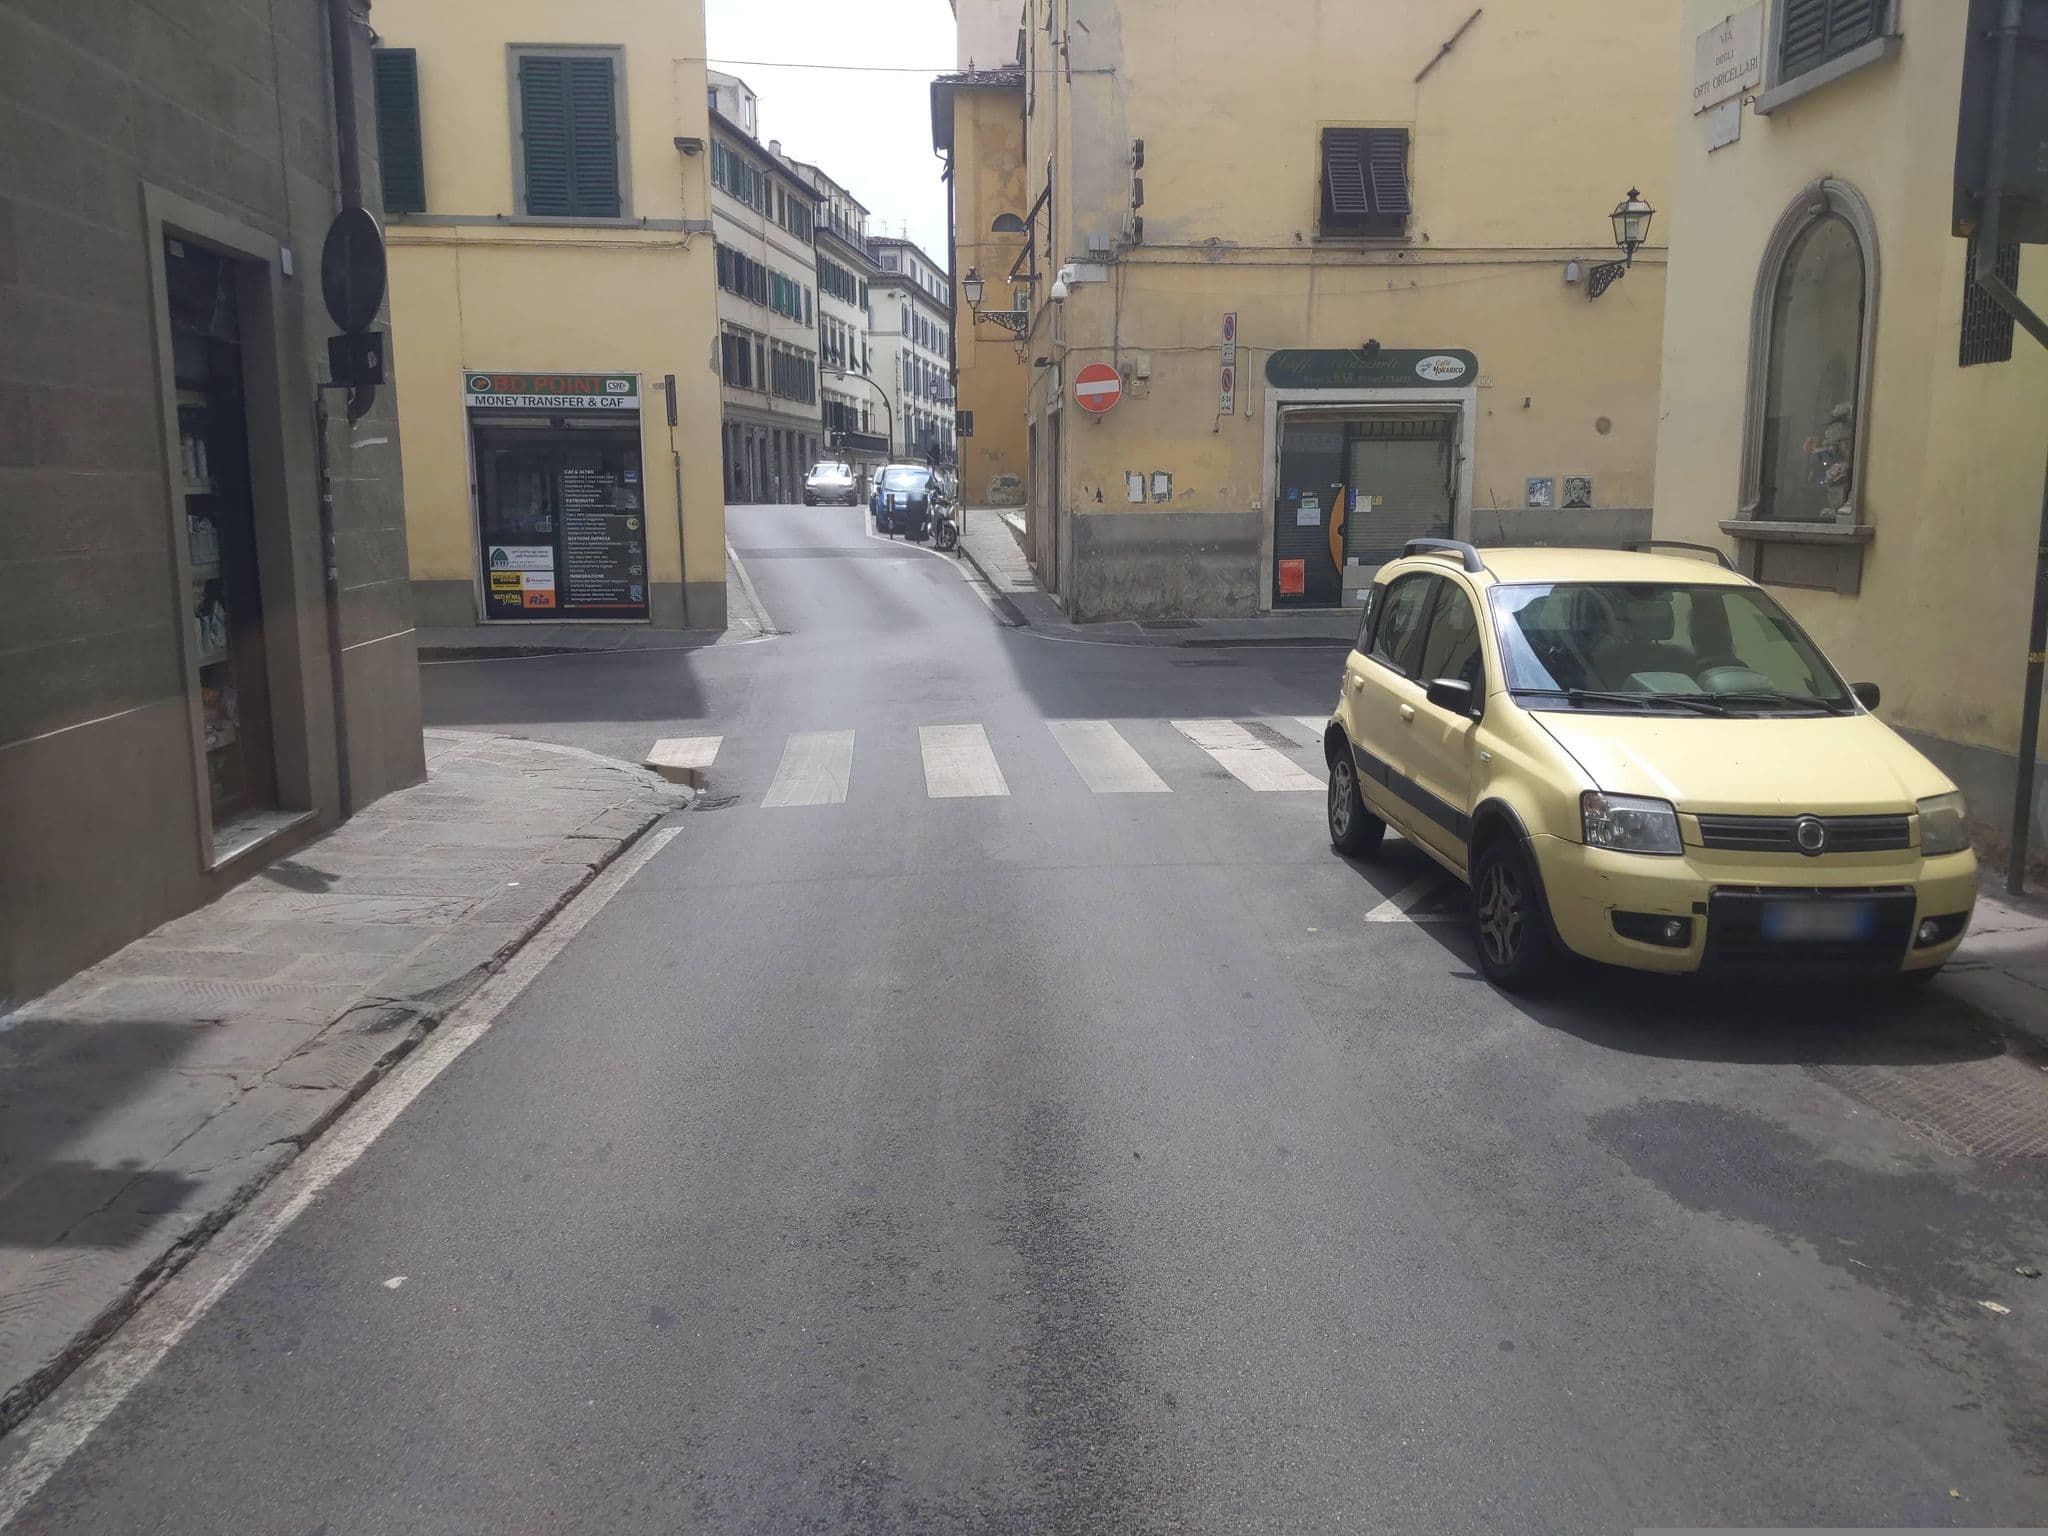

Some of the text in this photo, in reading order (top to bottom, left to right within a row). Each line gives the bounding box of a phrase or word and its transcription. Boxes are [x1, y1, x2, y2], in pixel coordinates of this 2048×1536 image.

[1720, 31, 1733, 44] VIA
[1715, 48, 1734, 66] DEGLI
[1693, 56, 1758, 98] ORTI ORICELLARI
[492, 375, 602, 395] BD POINT
[474, 395, 625, 407] MONEY TRANSFER & CAF
